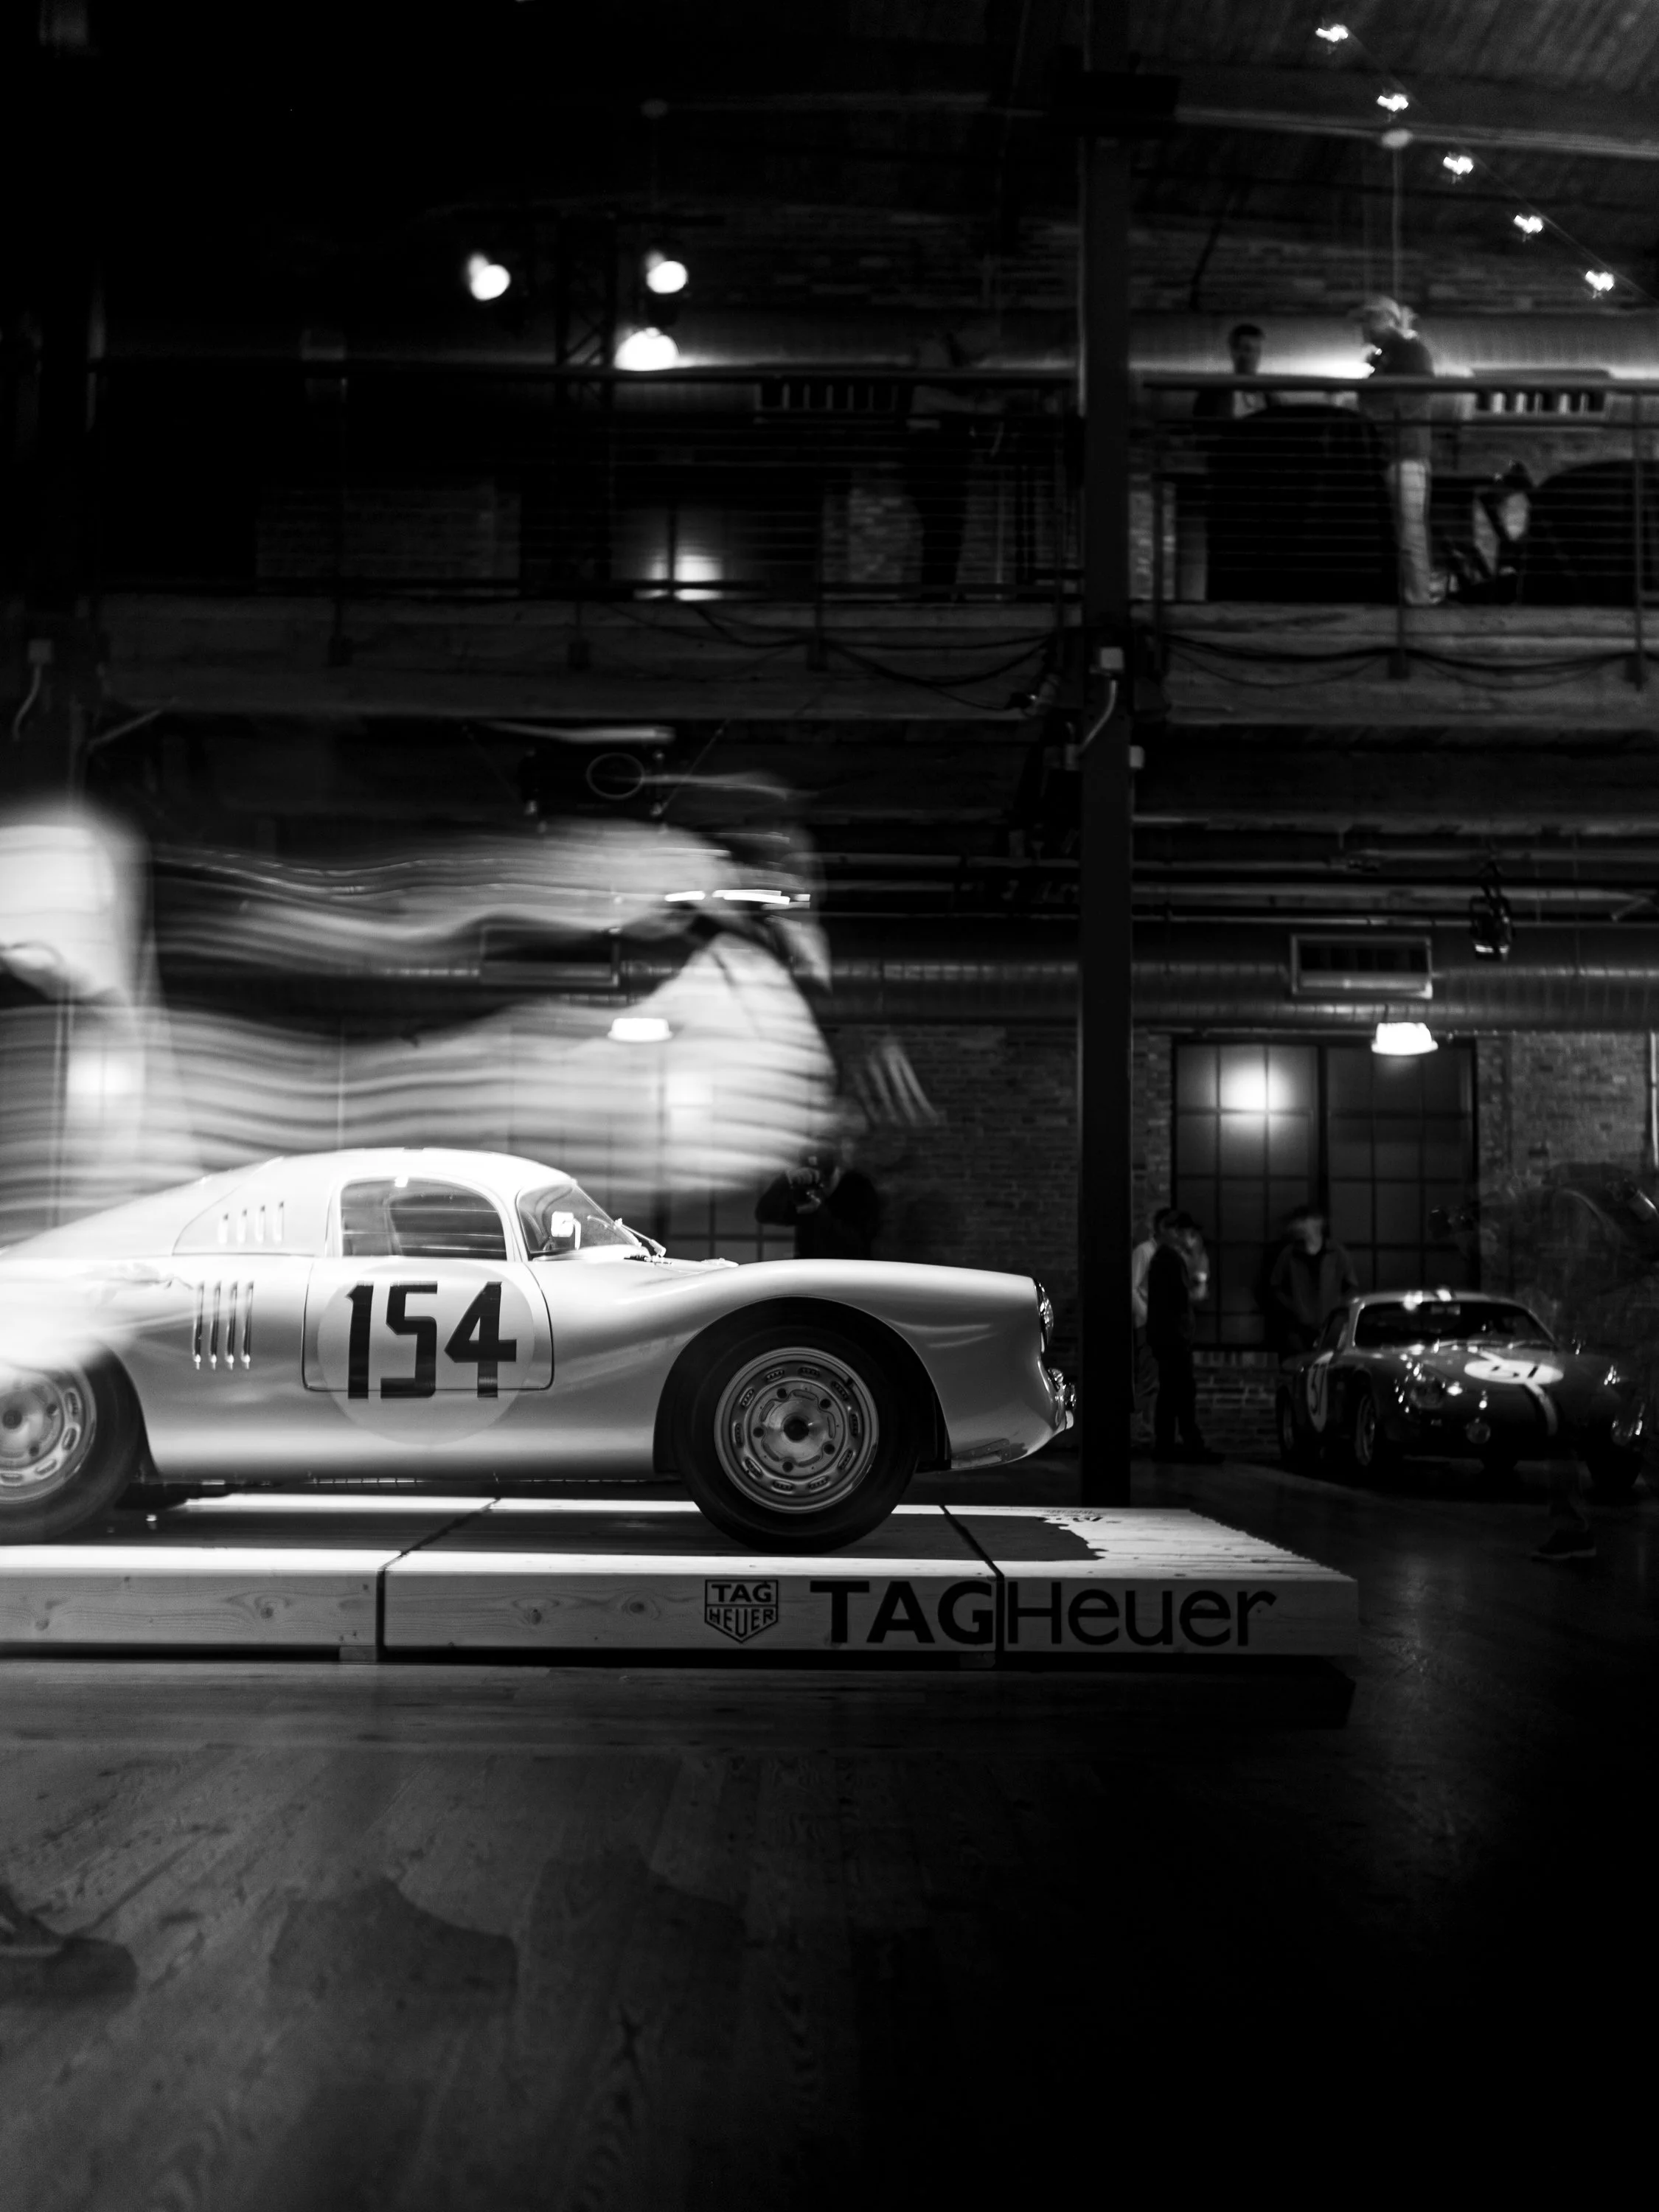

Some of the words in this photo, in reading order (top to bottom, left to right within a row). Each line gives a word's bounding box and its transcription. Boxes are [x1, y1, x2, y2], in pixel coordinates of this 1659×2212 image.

[344, 1281, 516, 1399] 154
[712, 1584, 771, 1602] TAG
[810, 1581, 993, 1644] TAG
[1009, 1582, 1276, 1646] Heuer
[709, 1609, 773, 1637] HEUER
